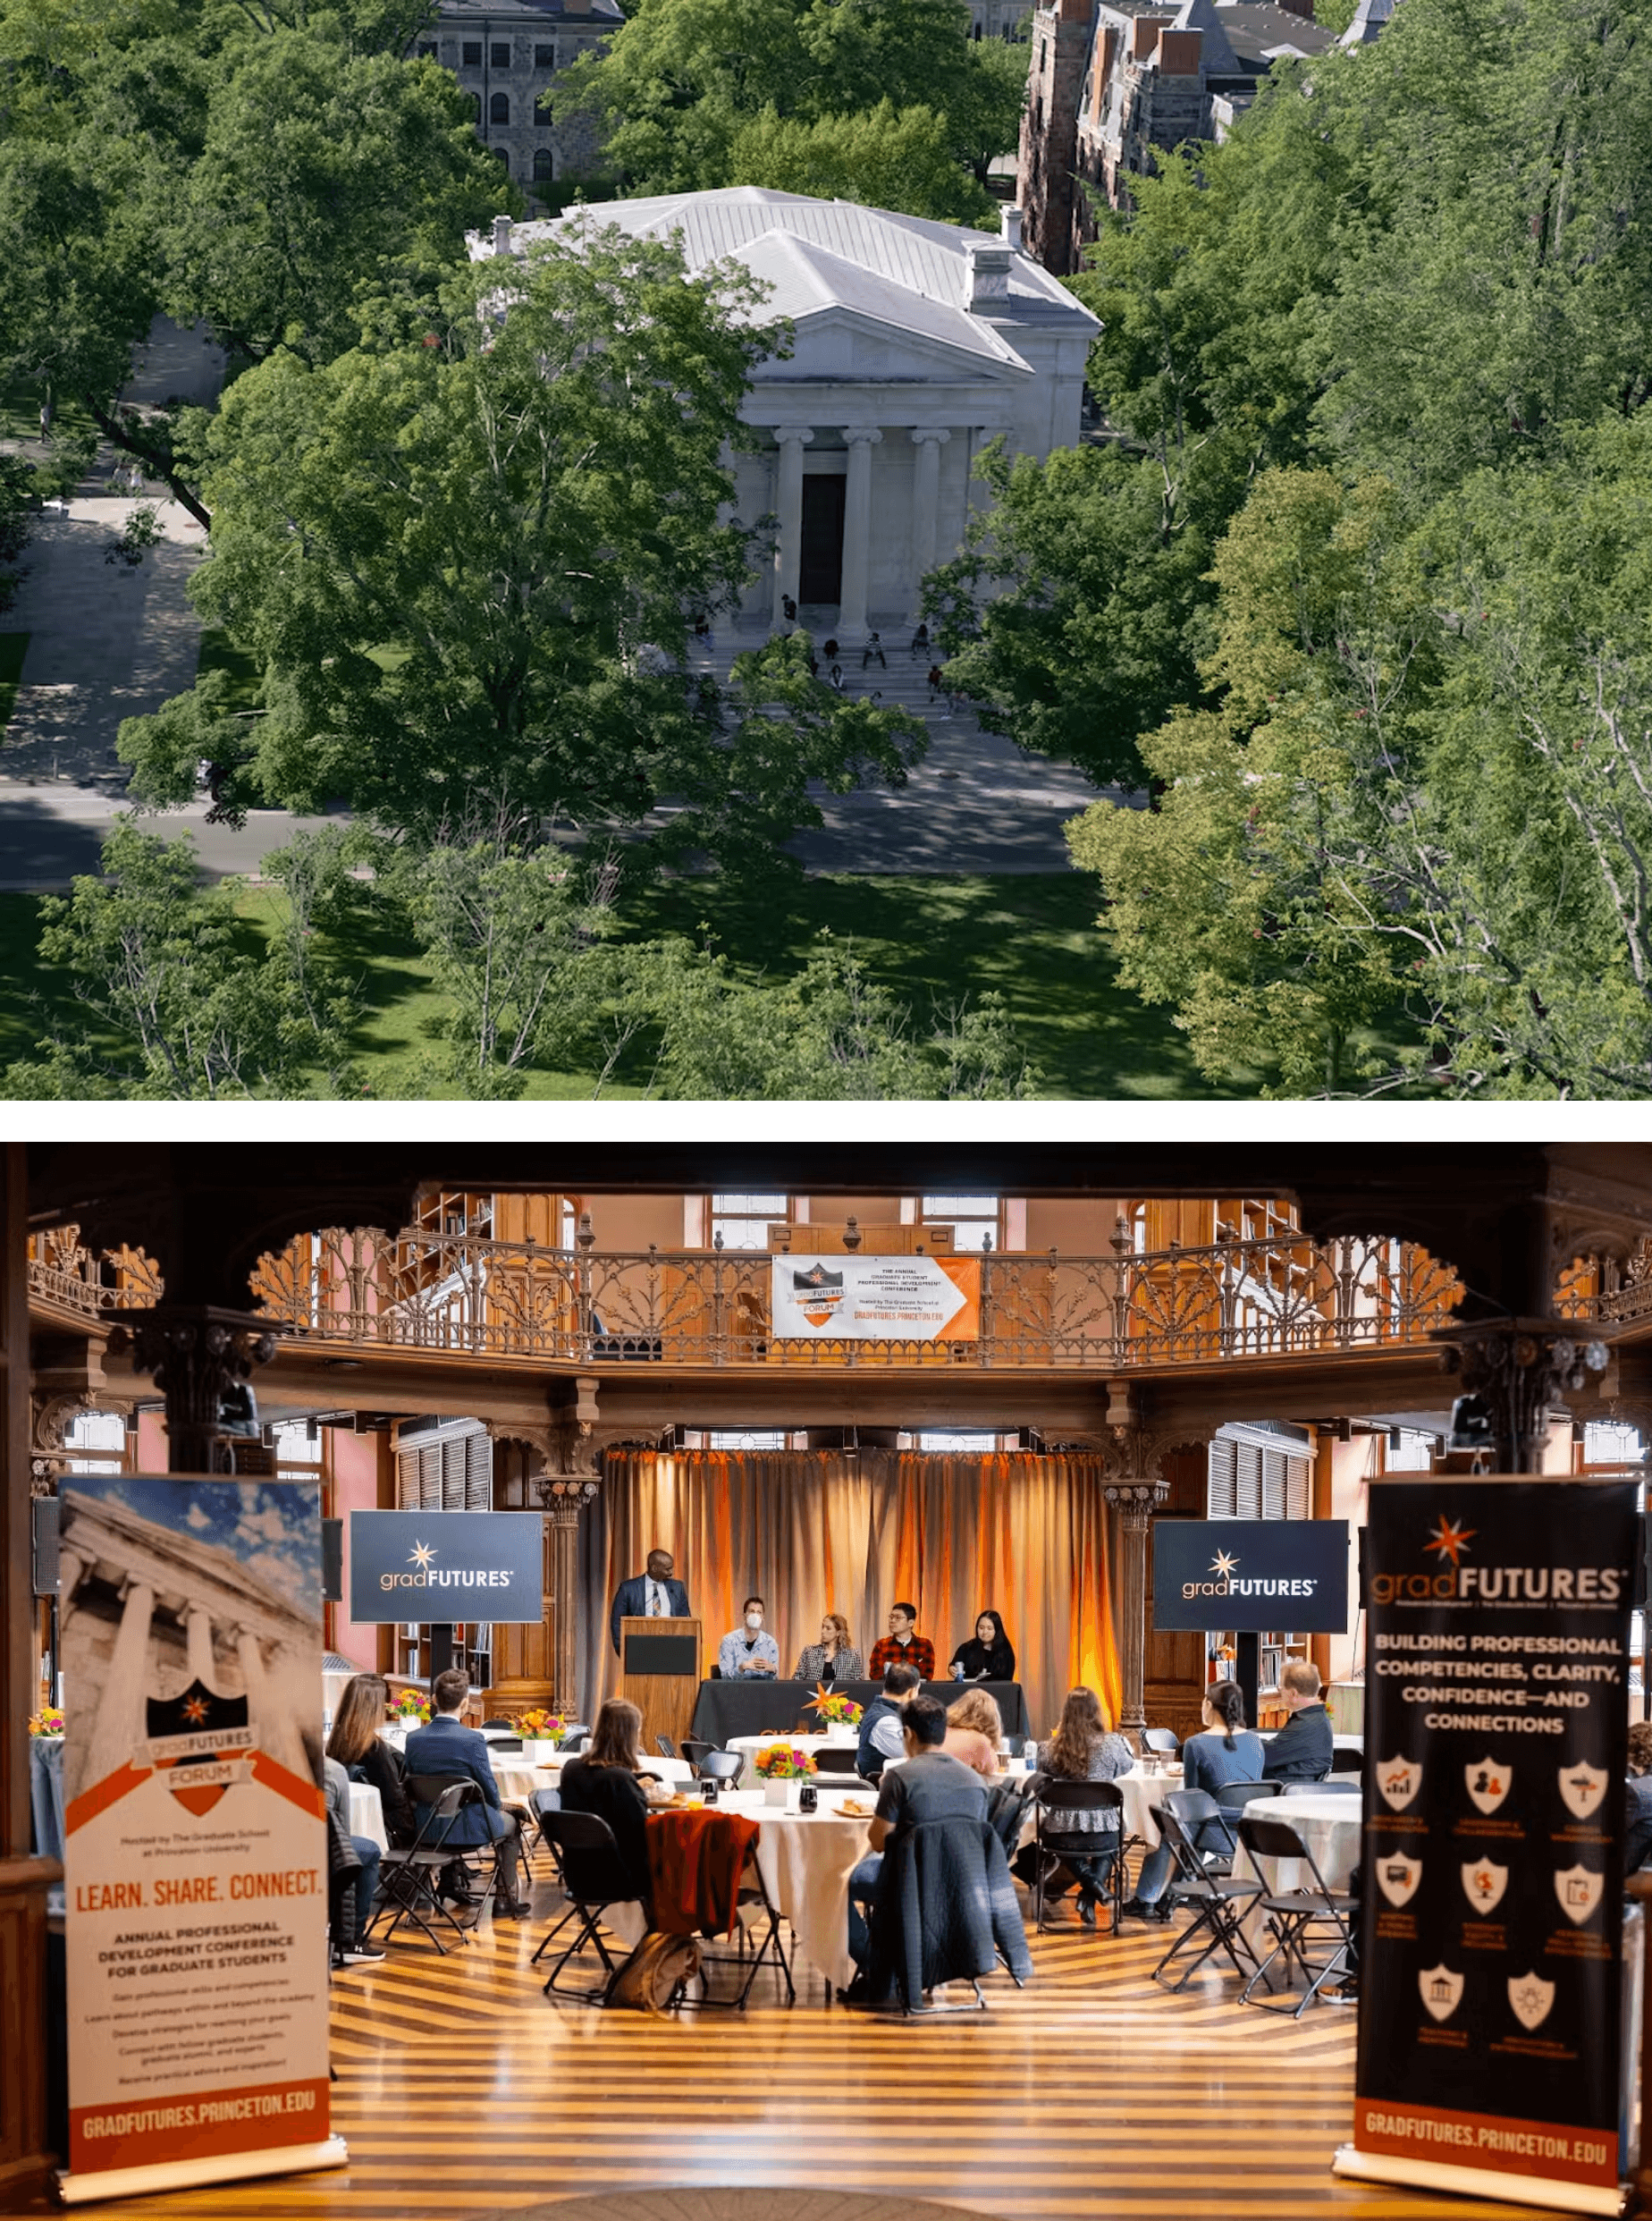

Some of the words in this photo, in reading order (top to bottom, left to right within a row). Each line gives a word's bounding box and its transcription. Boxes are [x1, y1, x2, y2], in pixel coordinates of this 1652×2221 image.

[804, 1304, 834, 1313] FORUM
[1375, 1634, 1467, 1651] BUILDING
[1471, 1635, 1623, 1655] PROFESSIONAL
[1375, 1659, 1529, 1682] COMPETENCIES,
[1531, 1663, 1621, 1684] CLARITY,
[1424, 1712, 1565, 1735] CONNECTIONS
[168, 1765, 232, 1786] FORUM
[76, 1881, 149, 1912] LEARN.
[154, 1876, 224, 1906] SHARE.
[230, 1869, 324, 1900] CONNECT.
[114, 1930, 173, 1945] ANNUAL
[175, 1921, 280, 1939] PROFESSIONAL
[98, 1944, 202, 1963] DEVELOPMENT
[205, 1935, 295, 1954] CONFERENCE
[107, 1965, 137, 1979] FOR
[139, 1959, 215, 1976] GRADUATE
[217, 1952, 287, 1969] STUDENTS
[82, 2090, 316, 2140] GRADFUTURES.PRINCETON.EDU
[1365, 2111, 1608, 2166] GRADFUTURES.PRINCETON.EDU
